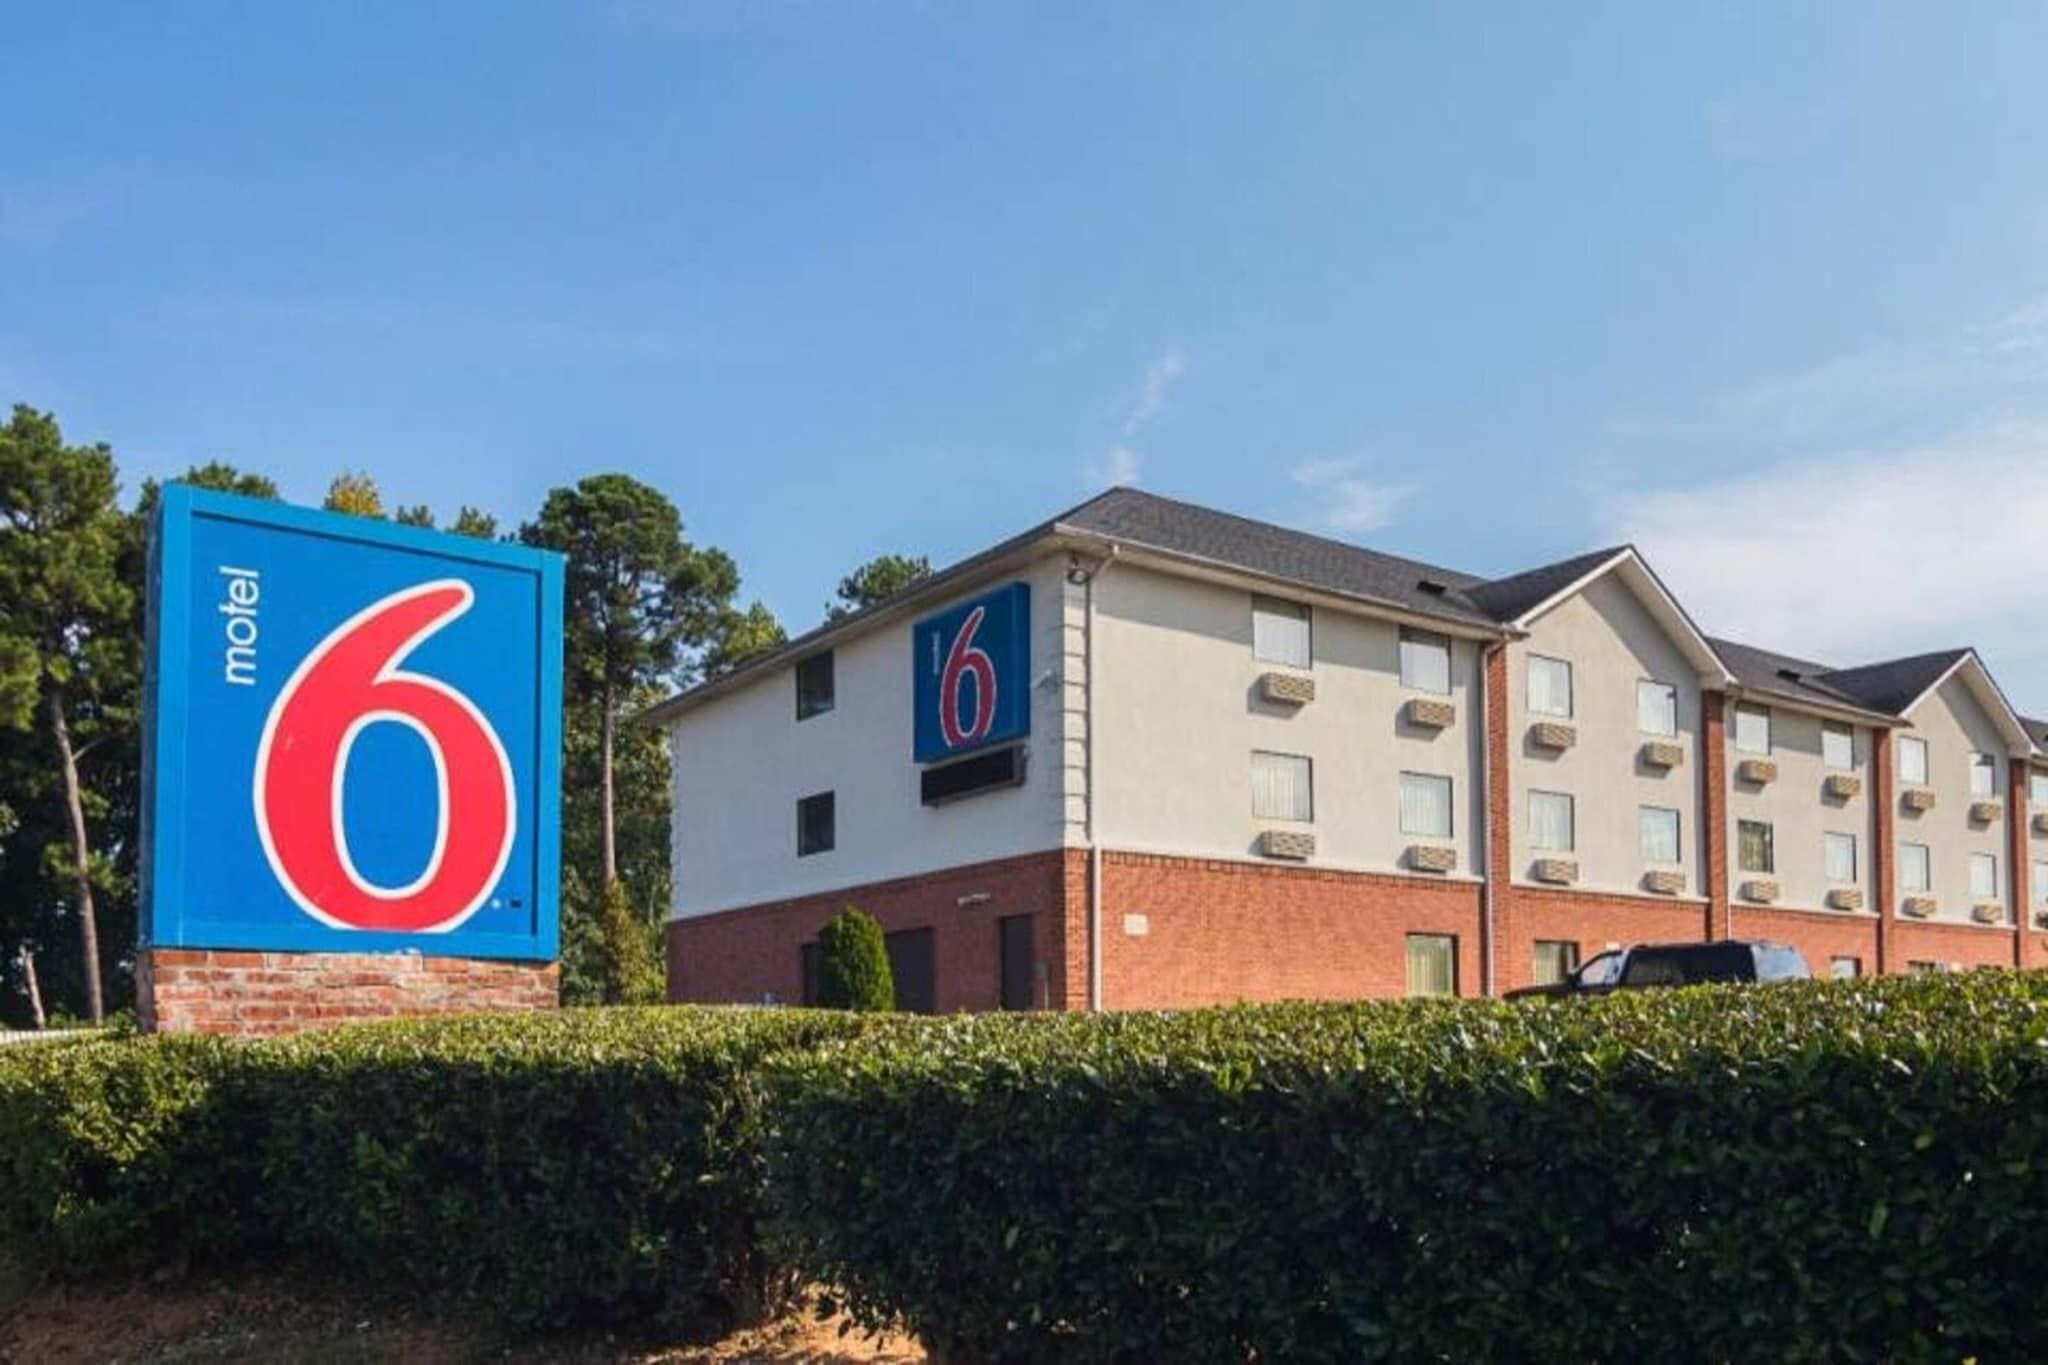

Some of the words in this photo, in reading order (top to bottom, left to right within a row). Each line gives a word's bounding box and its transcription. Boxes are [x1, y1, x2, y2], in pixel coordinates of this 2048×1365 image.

[219, 565, 260, 685] motel
[253, 578, 516, 932] 6
[940, 606, 996, 747] 6
